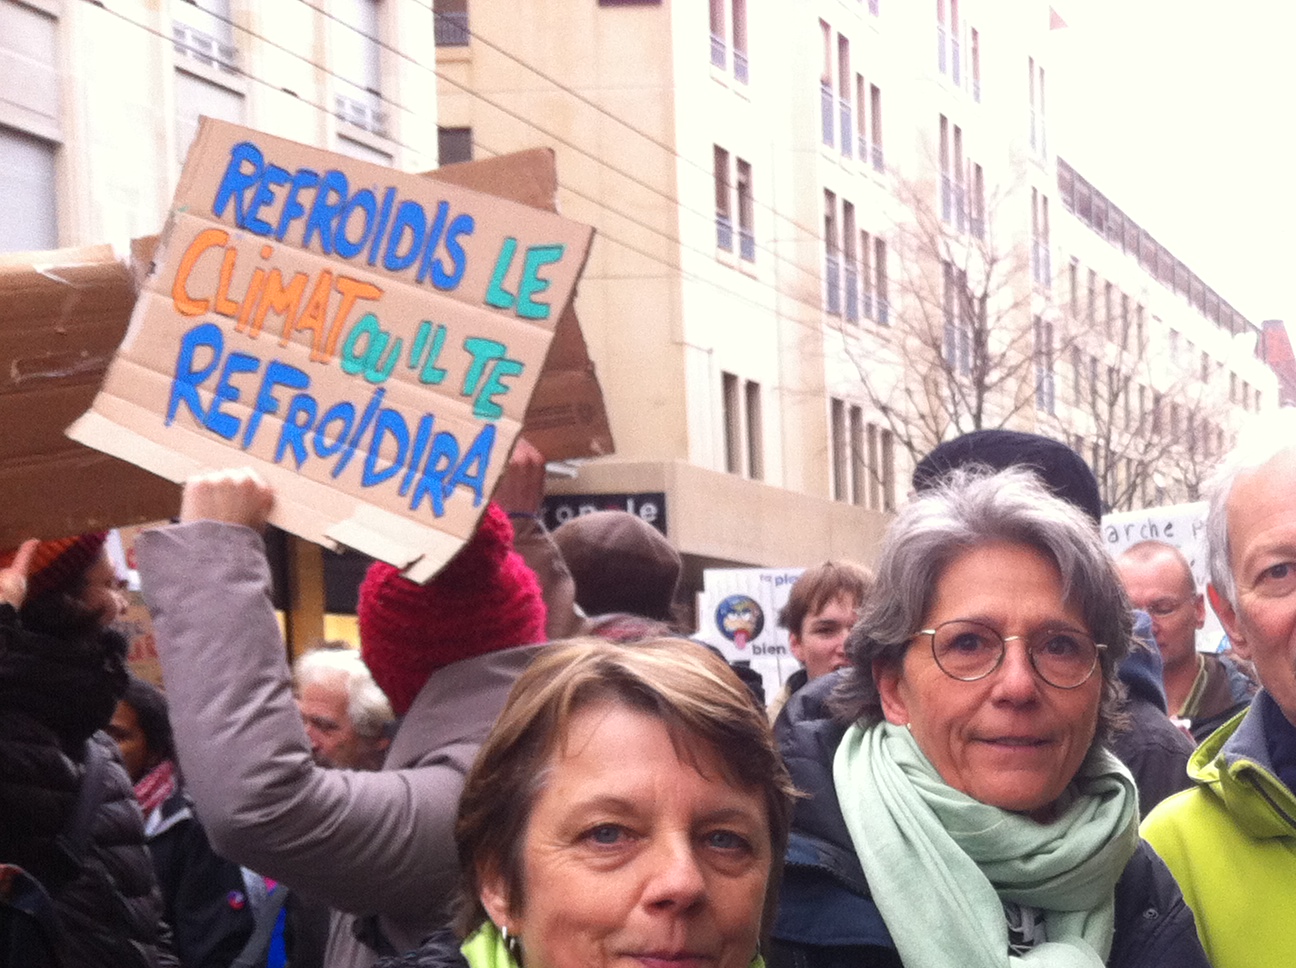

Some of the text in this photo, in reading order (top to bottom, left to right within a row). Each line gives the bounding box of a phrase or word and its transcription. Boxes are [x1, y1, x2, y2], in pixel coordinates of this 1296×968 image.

[213, 141, 567, 320] REFROIDIS LE
[165, 322, 497, 518] REFROIDIRA
[408, 320, 448, 385] IL
[461, 336, 525, 421] TE
[752, 643, 787, 656] bien
